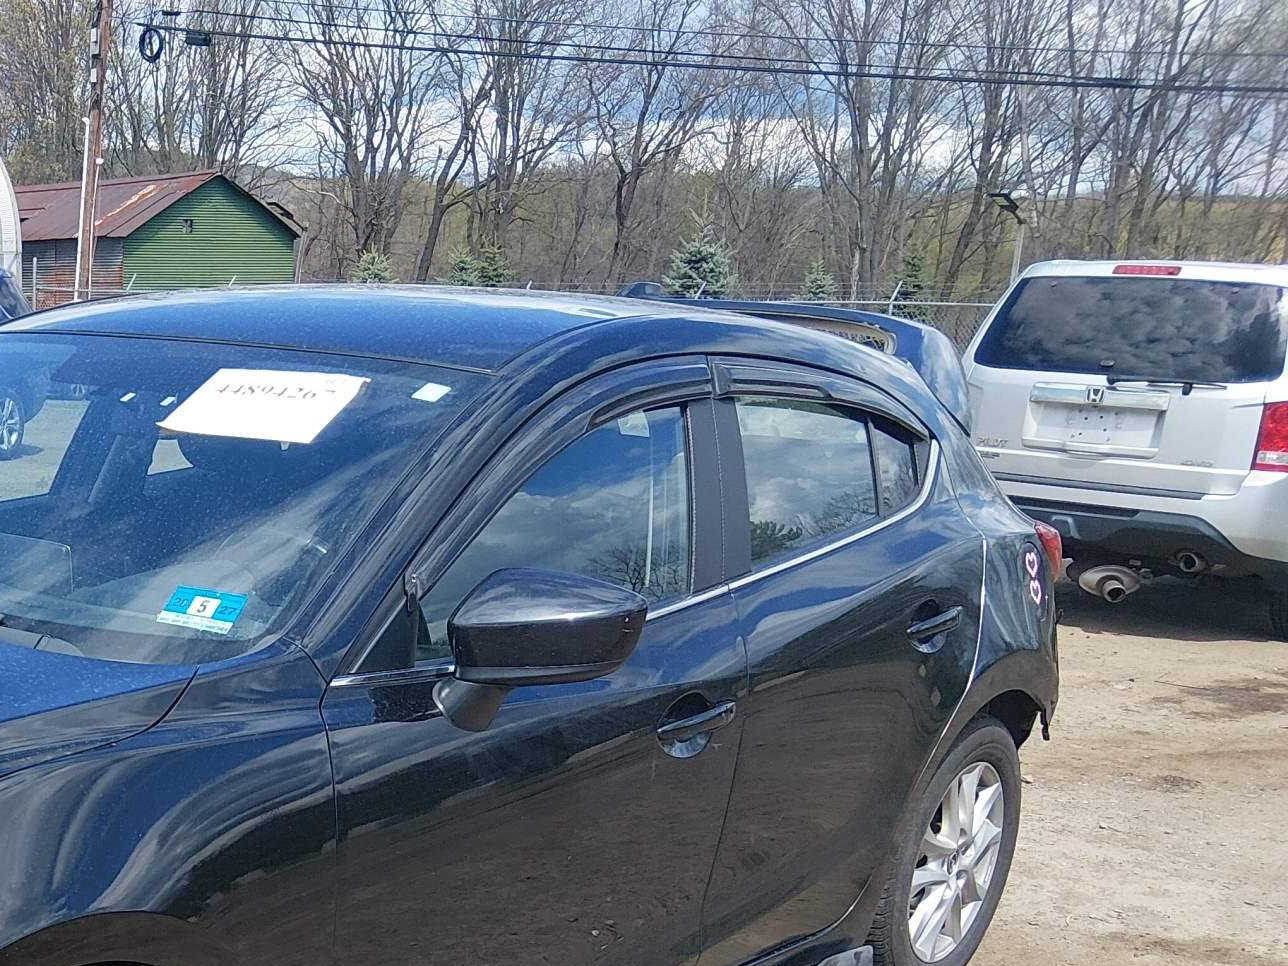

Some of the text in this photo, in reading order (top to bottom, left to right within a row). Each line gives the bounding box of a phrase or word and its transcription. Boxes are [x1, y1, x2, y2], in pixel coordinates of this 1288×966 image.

[172, 597, 239, 616] 20 5 27
